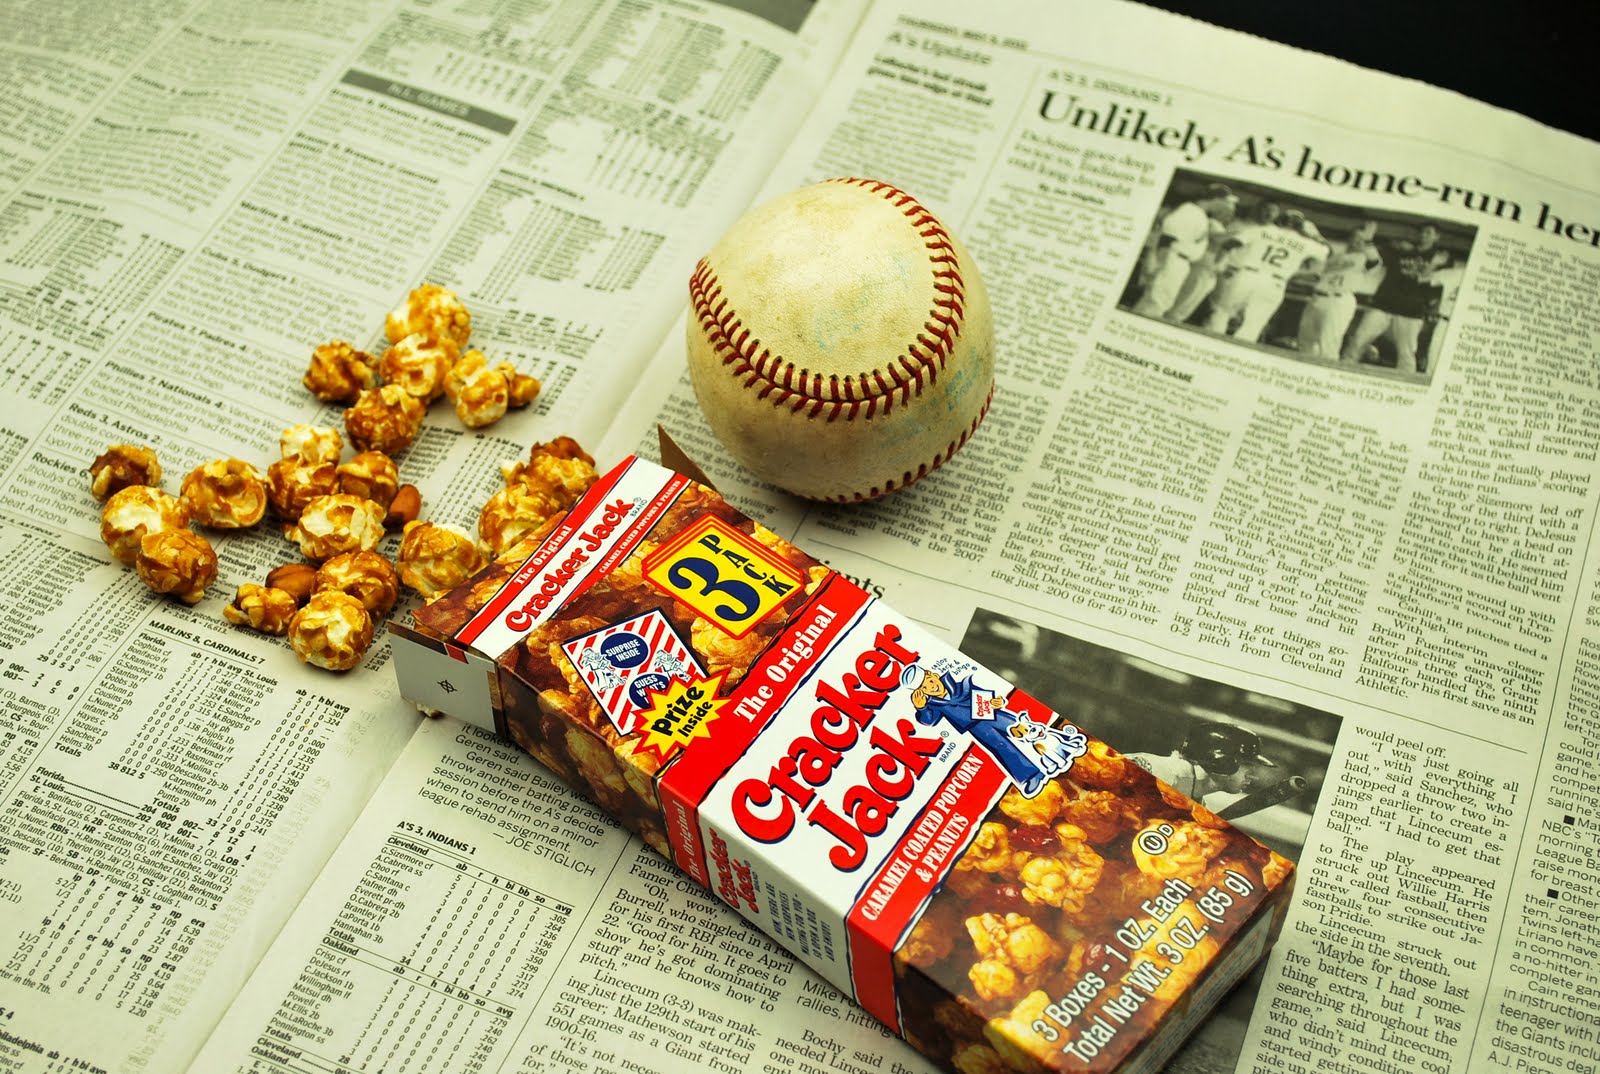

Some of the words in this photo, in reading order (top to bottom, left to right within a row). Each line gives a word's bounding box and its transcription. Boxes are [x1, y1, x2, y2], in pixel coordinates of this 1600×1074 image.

[1038, 88, 1220, 162] Unlikely
[1223, 133, 1286, 170] A's
[1295, 144, 1522, 224] home-run
[1261, 244, 1289, 268] 12
[1095, 342, 1161, 376] THURSDAY'S
[1162, 366, 1193, 384] GAME
[105, 361, 144, 381] Phillies
[158, 379, 212, 408] Nationals
[68, 402, 97, 420] Reds
[112, 419, 149, 441] Astros
[32, 452, 75, 478] Rockies
[599, 548, 622, 573] CARAMEL
[620, 528, 638, 550] COATED
[637, 506, 659, 530] POPCORN
[662, 479, 681, 502] PEANUTS
[629, 499, 648, 517] BRAND
[505, 548, 590, 632] Cracker
[579, 499, 634, 552] Jack
[513, 566, 536, 586] The
[532, 526, 572, 565] Original
[698, 534, 794, 597] PACK
[668, 557, 760, 621] 3
[1012, 564, 1040, 581] Still,
[1041, 573, 1092, 595] DeJesus
[1092, 590, 1126, 605] came
[1126, 598, 1139, 608] in
[1140, 601, 1161, 614] hit-
[133, 639, 162, 654] Coghlan
[139, 632, 166, 647] Florida
[149, 620, 192, 640] MARLINS
[193, 635, 200, 644] 8,
[203, 639, 257, 663] CARDINALS
[605, 639, 640, 657] SURPRISE
[615, 649, 640, 662] INSIDE
[1170, 624, 1191, 637] 0-2
[1198, 633, 1231, 648] pitch
[1240, 643, 1271, 659] from
[1281, 653, 1343, 679] Cleveland
[244, 669, 254, 678] St.
[256, 674, 278, 686] Louis
[634, 674, 658, 689] GUESS
[734, 690, 774, 724] The
[765, 604, 838, 682] Original
[1355, 675, 1409, 699] Athletic.
[677, 701, 713, 737] Inside
[976, 694, 984, 717] Cracker
[983, 700, 991, 714] Jack
[455, 734, 491, 754] Geren
[493, 750, 520, 766] said.
[731, 624, 921, 845] Cracker
[938, 742, 956, 763] BRAND
[1355, 726, 1395, 743] would
[1396, 737, 1423, 751] peel
[1426, 745, 1447, 759] off.
[440, 754, 476, 774] throw
[477, 769, 526, 793] another
[526, 787, 570, 811] batting
[570, 804, 621, 828] practice
[806, 718, 944, 874] Jack
[396, 820, 414, 832] A'S
[415, 825, 424, 835] 3,
[426, 829, 469, 852] INDIANS
[469, 847, 477, 855] 1
[417, 787, 459, 808] league
[460, 803, 497, 824] rehab
[497, 818, 571, 854] assignment.
[672, 800, 695, 856] Original
[861, 858, 912, 921] CARAMEL
[902, 809, 944, 861] COATED
[934, 753, 984, 815] POPCORN
[1331, 795, 1359, 811] jam
[1370, 805, 1398, 821] that
[1408, 815, 1473, 845] Lincecum
[1484, 841, 1504, 852] es-
[1542, 819, 1582, 840] NBC's
[380, 846, 424, 867] G.Sizemore
[387, 836, 429, 856] Cleveland
[506, 836, 536, 852] JOE
[533, 844, 596, 877] STIGLICH
[922, 812, 969, 872] PEANUTS
[689, 857, 703, 882] The
[709, 827, 741, 909] Cracker
[732, 858, 760, 914] Jack
[915, 868, 933, 883] &
[1223, 870, 1255, 897] g)
[1315, 856, 1359, 875] struck
[1366, 871, 1390, 884] out
[1398, 877, 1437, 897] Willie
[1444, 894, 1491, 912] Harris
[1140, 877, 1194, 924] Each
[1195, 886, 1234, 924] (85
[322, 936, 359, 956] Oakland
[1115, 917, 1157, 951] OZ.
[1169, 916, 1210, 951] OZ.
[1518, 926, 1563, 948] Liriano
[1567, 941, 1598, 959] have
[315, 947, 336, 961] Crisp
[336, 956, 347, 965] cf
[1103, 943, 1128, 963] 1
[1156, 943, 1184, 965] 3
[1127, 960, 1172, 993] Wt.
[593, 969, 660, 1000] Lincecum
[662, 993, 694, 1013] (3-3)
[697, 1007, 724, 1024] was
[726, 1018, 762, 1037] mak-
[796, 995, 842, 1020] rallies,
[845, 1009, 892, 1038] hitting
[1044, 971, 1106, 1028] Boxes
[1101, 984, 1147, 1025] Net
[544, 1015, 598, 1043] 1900-16.
[1032, 1019, 1059, 1042] 3
[1063, 1016, 1117, 1064] Total
